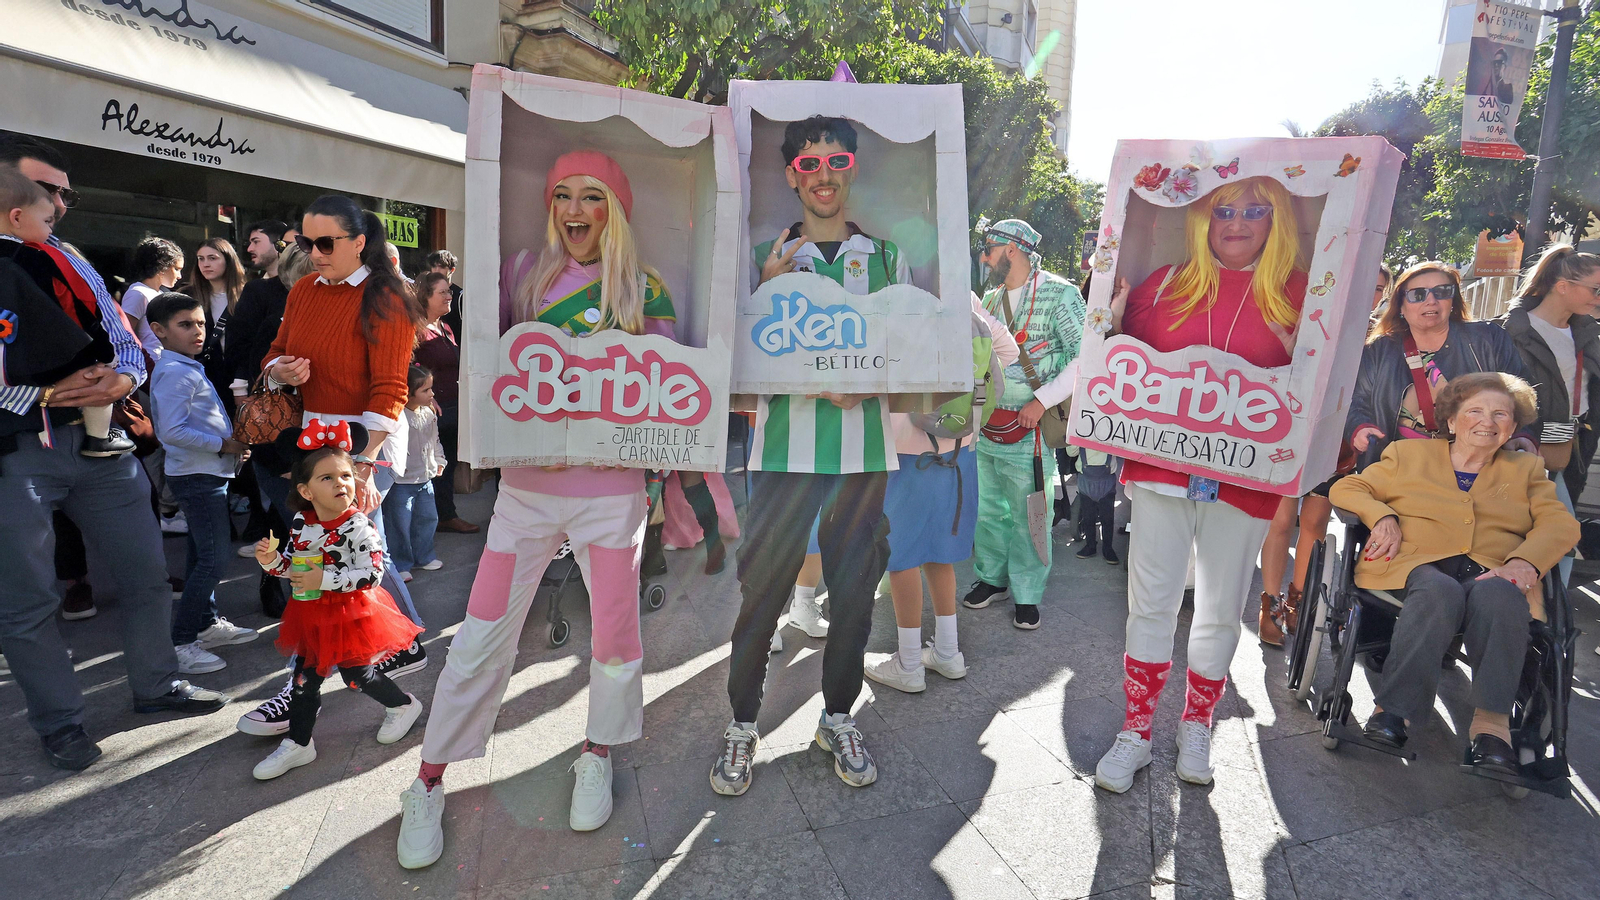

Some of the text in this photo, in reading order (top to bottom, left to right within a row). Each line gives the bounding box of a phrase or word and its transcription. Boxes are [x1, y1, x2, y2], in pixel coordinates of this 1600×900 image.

[61, 0, 208, 51] desde 1979
[1490, 15, 1534, 34] FESTIVAL
[1494, 4, 1530, 21] TIO PEPE
[102, 99, 256, 155] Alexandra
[1486, 125, 1494, 133] 10
[147, 143, 222, 166] desde 1979
[758, 297, 864, 353] Ken
[499, 343, 701, 420] Barbie
[1090, 350, 1282, 433] Barbie
[612, 426, 701, 446] JARTIBLE DE
